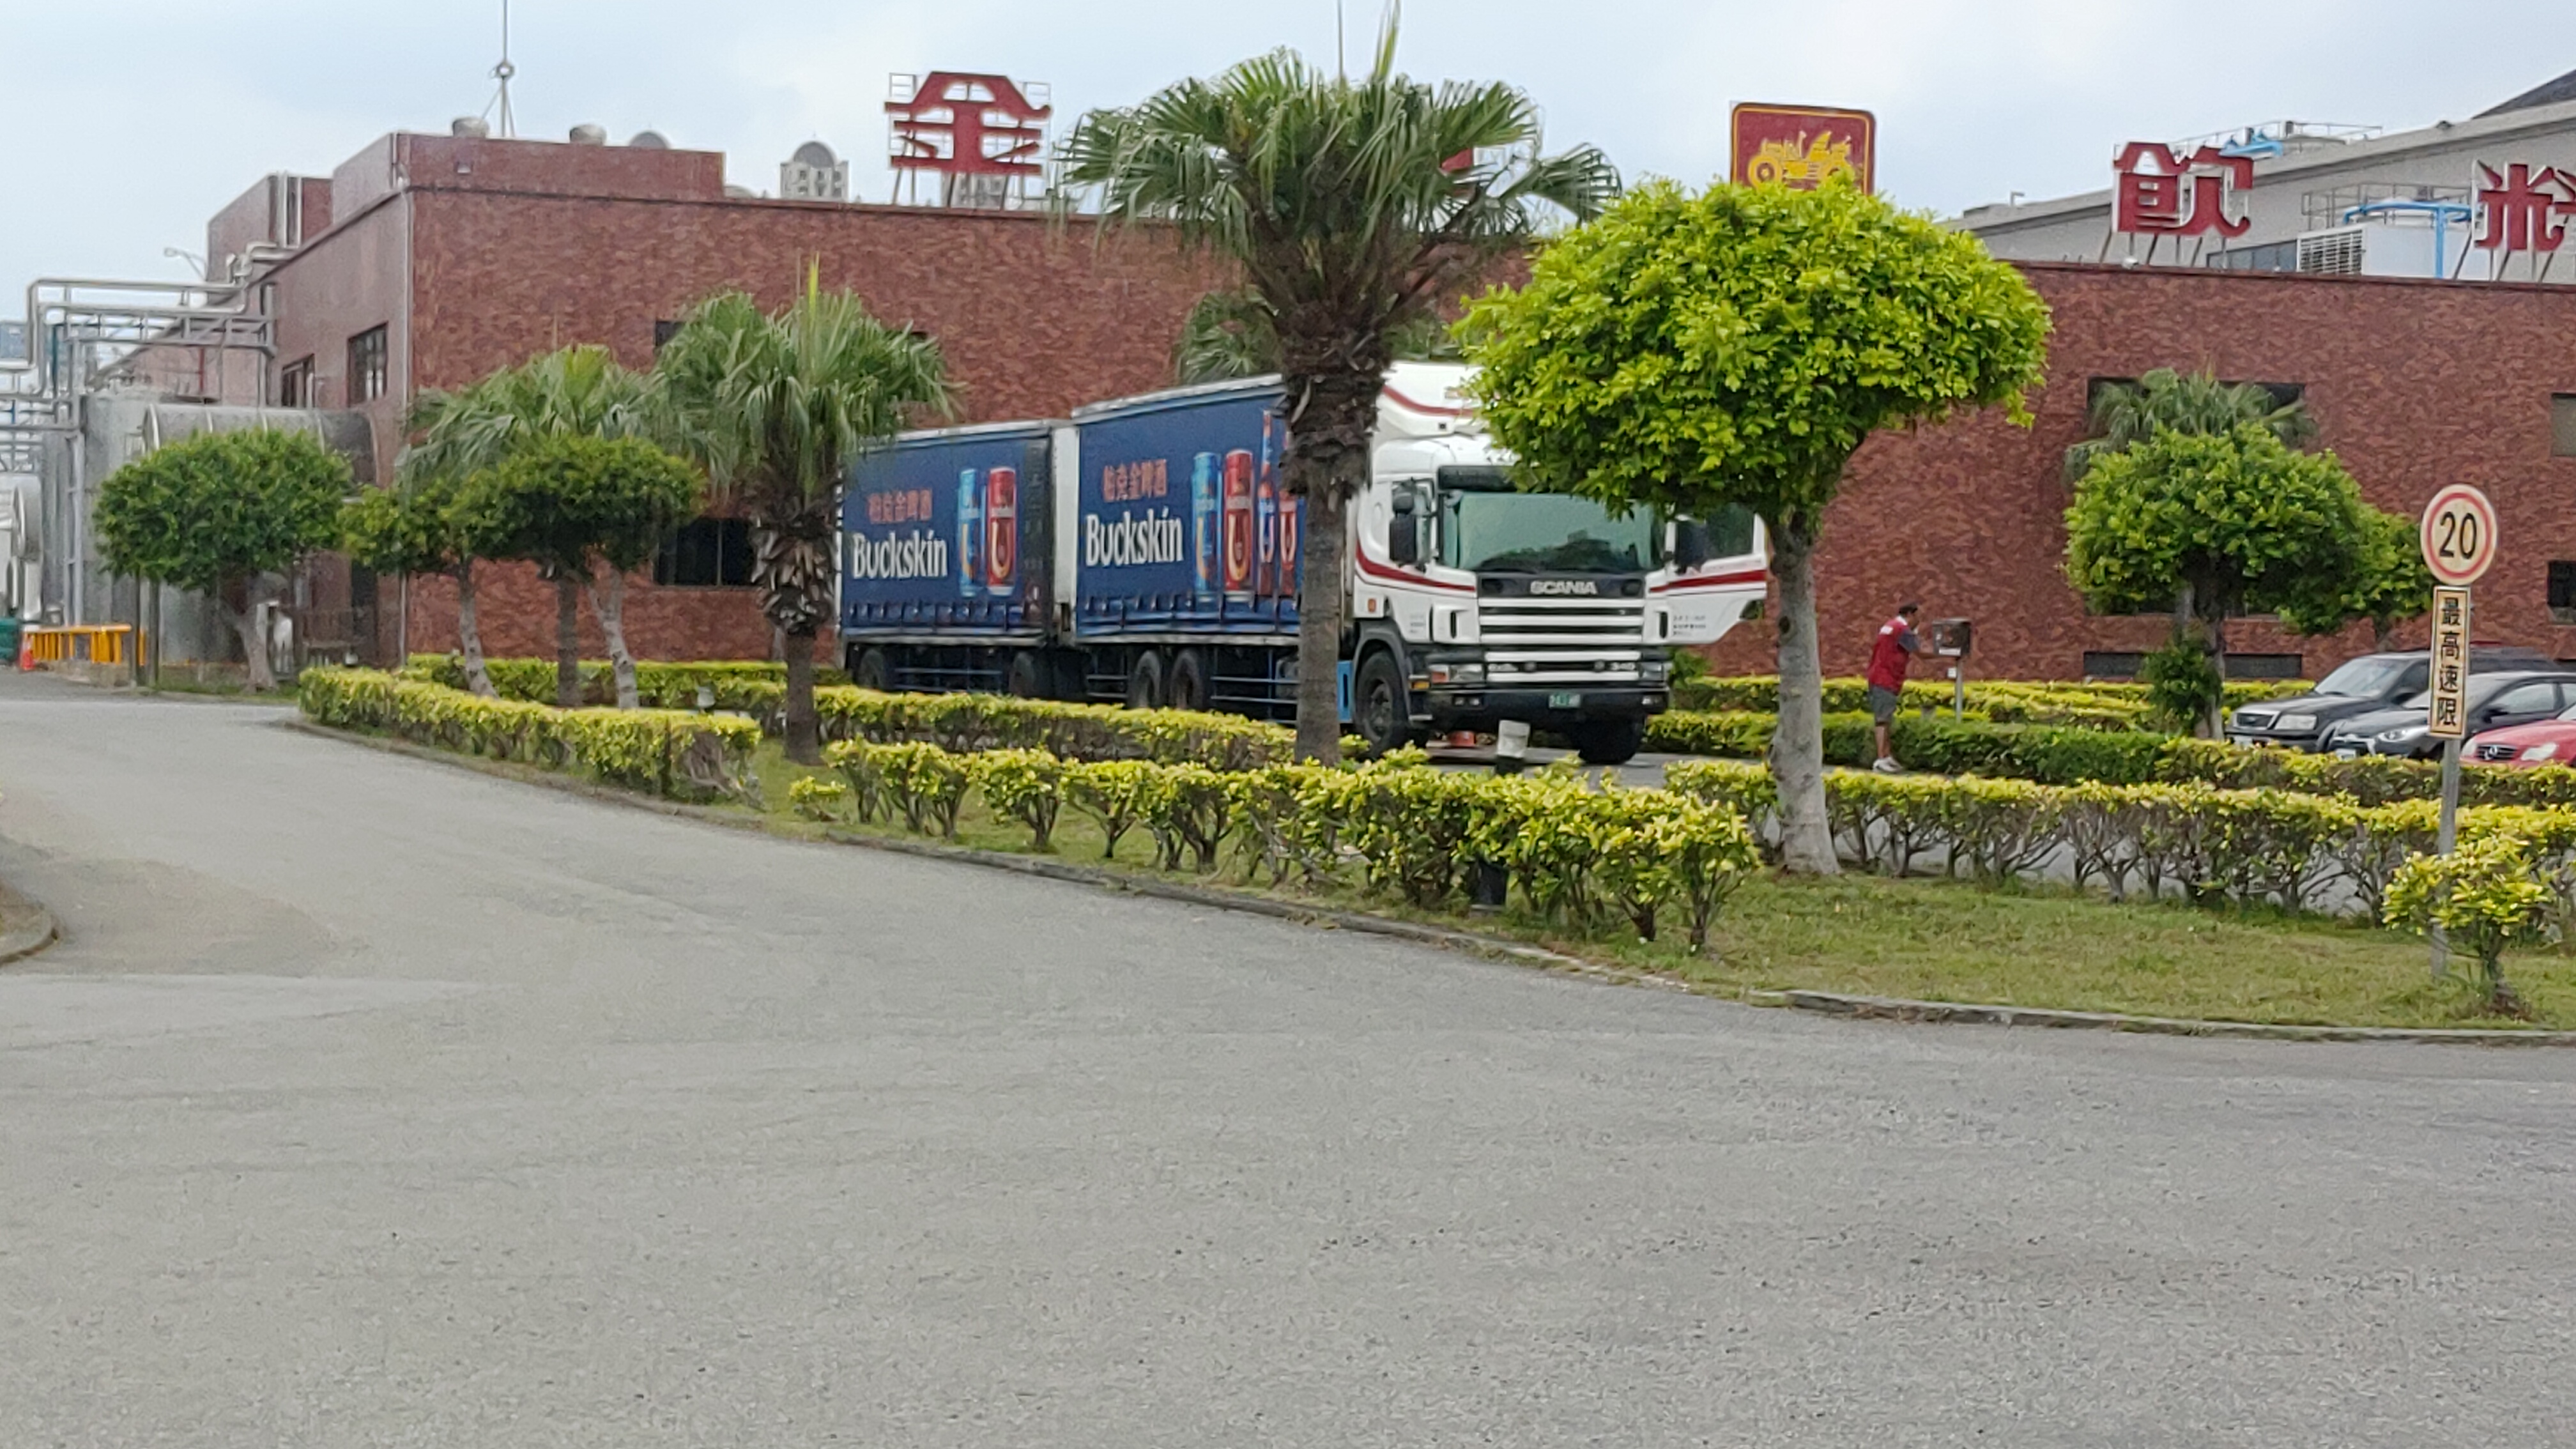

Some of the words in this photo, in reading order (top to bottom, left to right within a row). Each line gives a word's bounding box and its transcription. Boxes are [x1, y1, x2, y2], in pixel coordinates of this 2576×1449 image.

[884, 70, 1052, 176] 金
[852, 529, 948, 579] Buckskin
[1085, 505, 1184, 567] Buckskin
[2439, 511, 2477, 560] 20
[1530, 579, 1598, 595] SCANIA
[2437, 597, 2461, 727] 最高速限
